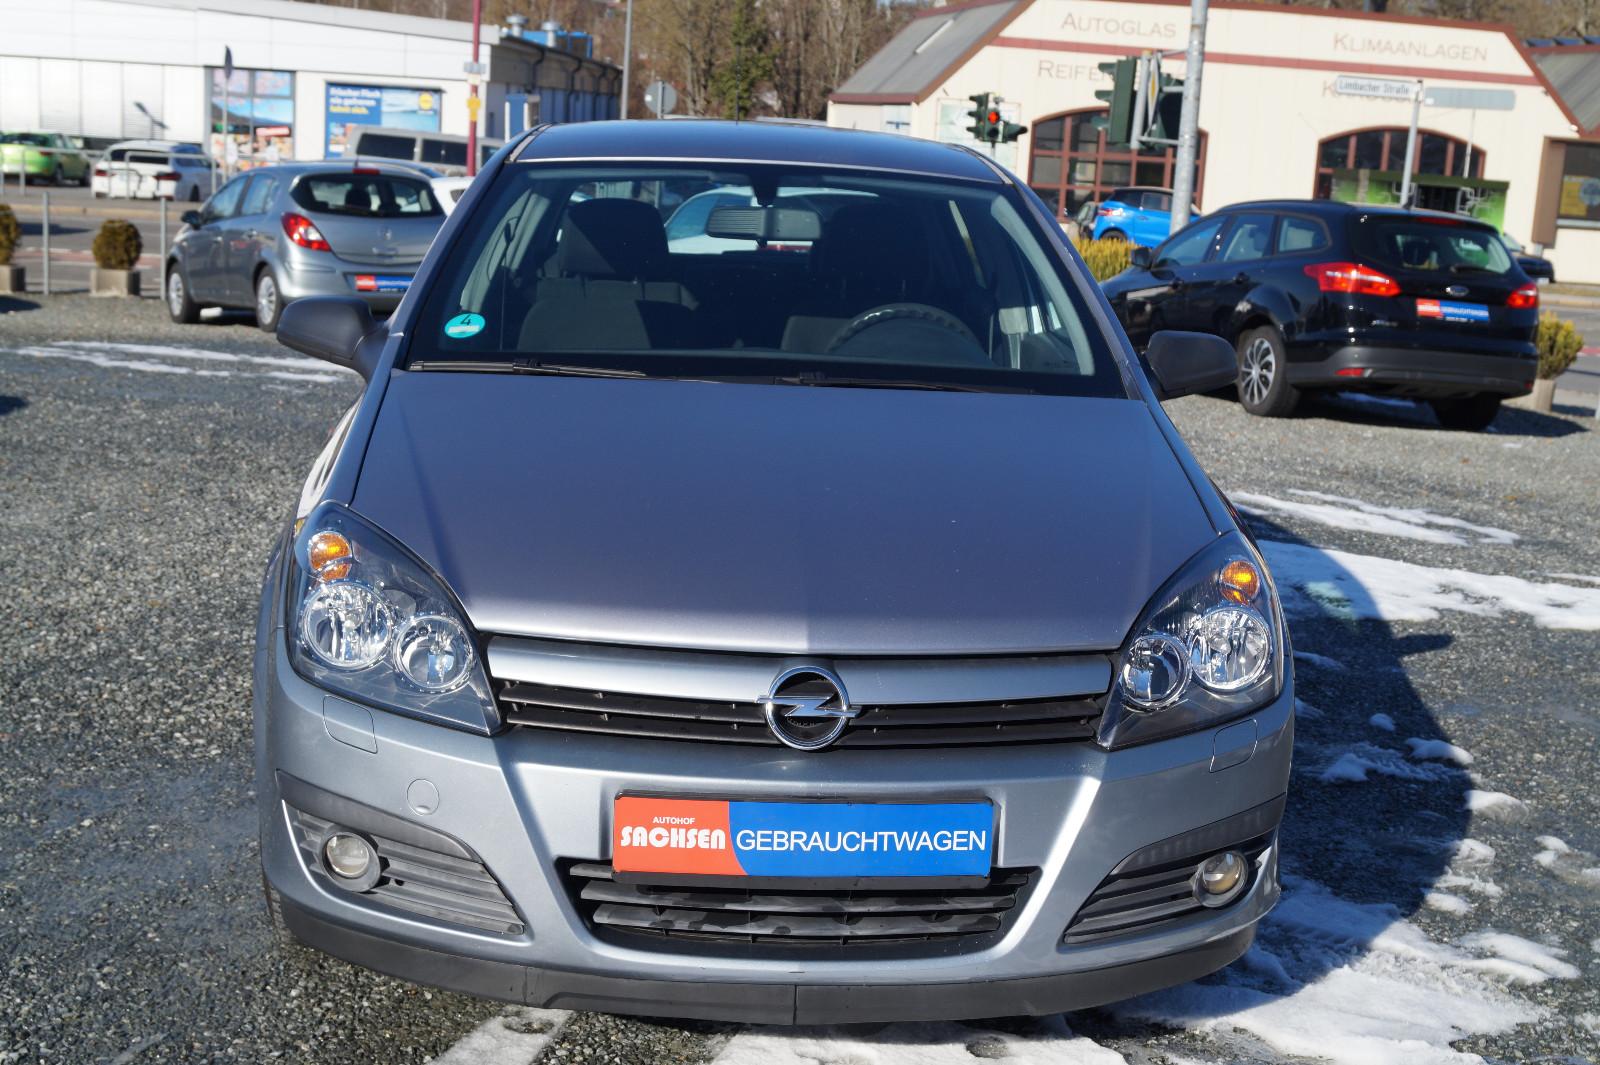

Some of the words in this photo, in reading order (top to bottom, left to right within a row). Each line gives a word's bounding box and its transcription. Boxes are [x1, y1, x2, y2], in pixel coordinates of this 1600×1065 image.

[1384, 83, 1409, 95] Straße
[653, 816, 695, 825] AUTOHOF
[620, 826, 726, 850] SACHSEN
[736, 830, 986, 853] GEBRAUCHTWAGEN
